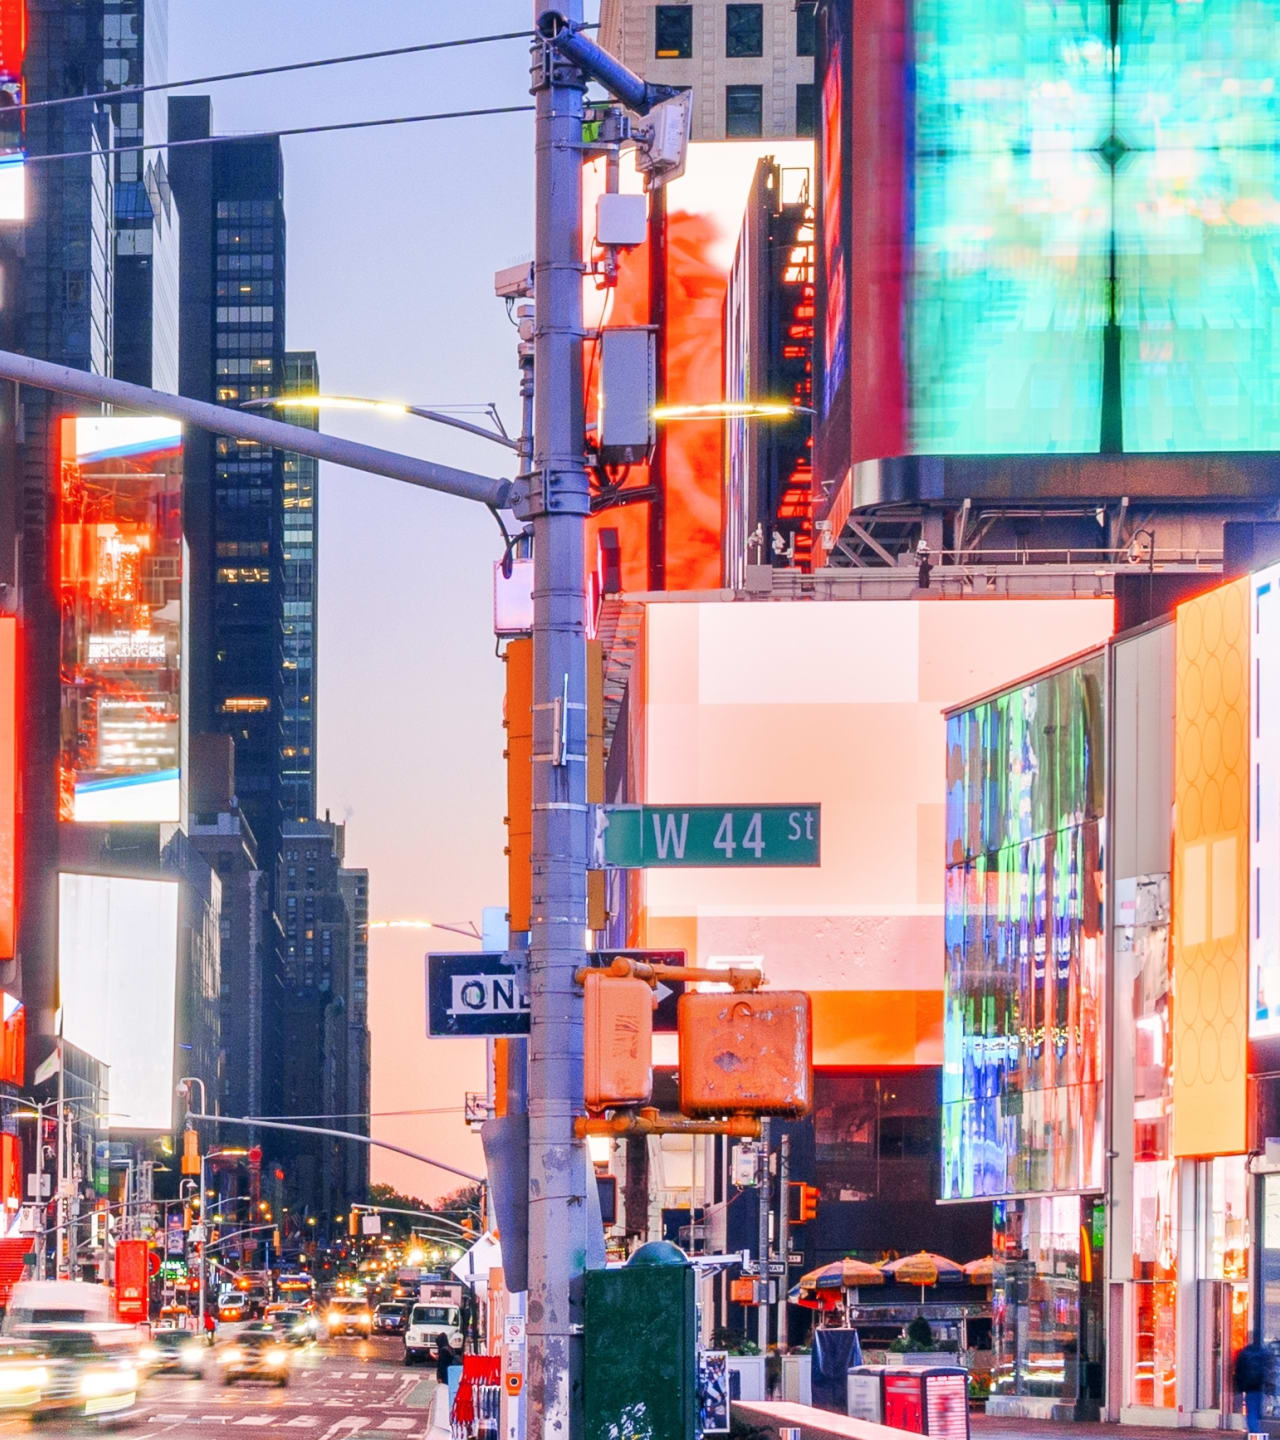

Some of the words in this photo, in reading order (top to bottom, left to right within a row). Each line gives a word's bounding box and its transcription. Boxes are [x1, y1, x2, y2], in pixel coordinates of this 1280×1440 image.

[652, 813, 689, 859] W
[713, 812, 766, 859] 44
[788, 811, 814, 841] St
